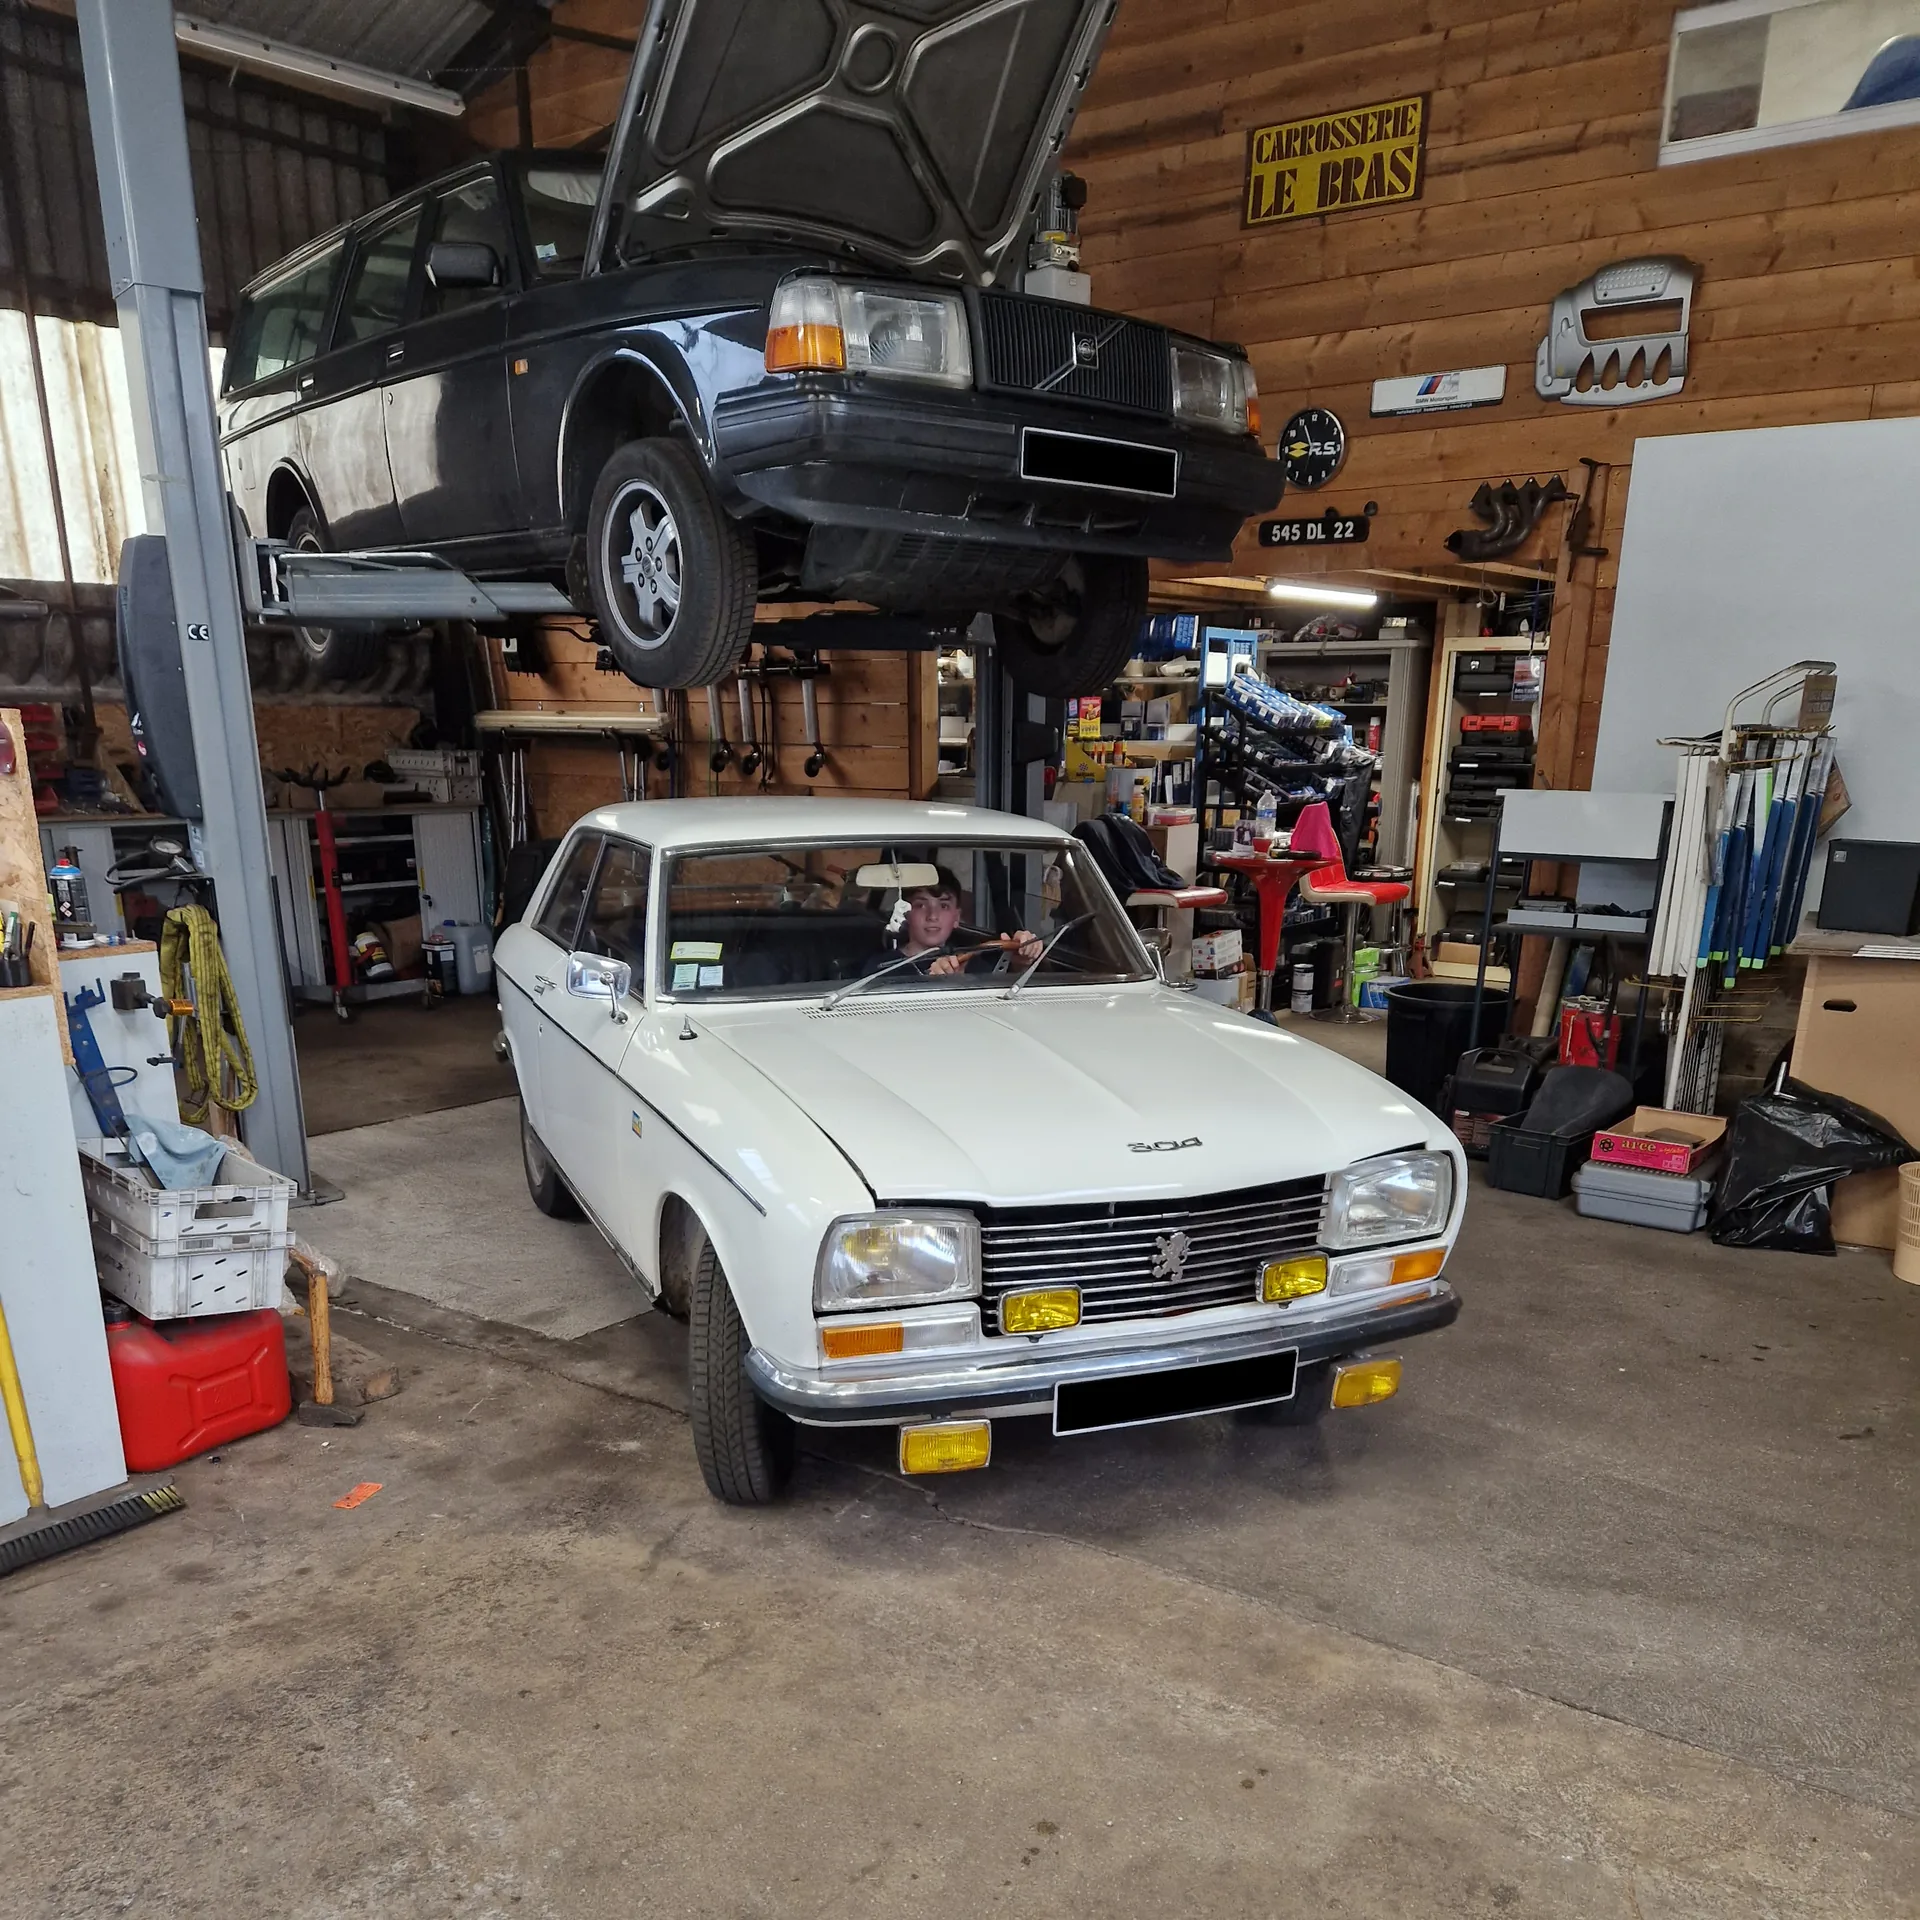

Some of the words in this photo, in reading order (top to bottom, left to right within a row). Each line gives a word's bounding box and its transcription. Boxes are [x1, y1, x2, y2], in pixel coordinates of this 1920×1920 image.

[1255, 103, 1418, 164] CARROSSERIE
[1251, 168, 1298, 219] LE
[1317, 146, 1415, 208] BRAS
[1271, 524, 1301, 542] 545
[1306, 523, 1326, 540] DL
[1333, 521, 1354, 538] 22
[188, 624, 209, 640] CE
[1126, 1137, 1203, 1152] 304
